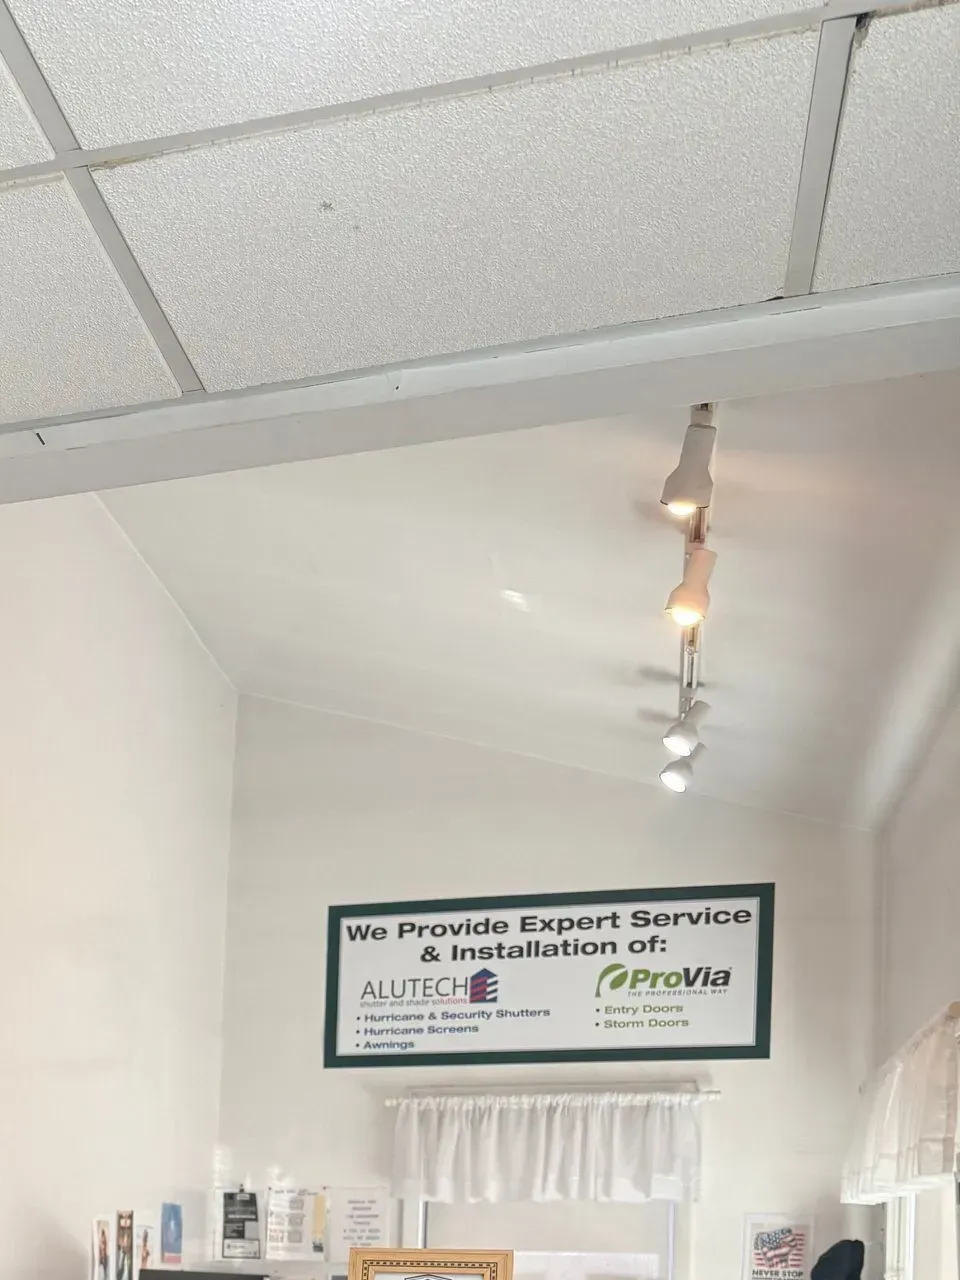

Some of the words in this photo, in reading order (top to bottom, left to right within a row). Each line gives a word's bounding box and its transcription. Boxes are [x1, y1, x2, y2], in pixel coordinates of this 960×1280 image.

[346, 924, 387, 942] We
[397, 917, 509, 939] Provide
[520, 912, 621, 935] Expert
[630, 907, 752, 928] Service
[420, 946, 441, 962] &
[451, 939, 617, 962] Installation
[628, 935, 667, 954] of:
[628, 966, 732, 990] ProVia
[360, 977, 468, 1000] ALUTECH
[360, 1000, 387, 1008] shutter
[390, 999, 404, 1007] and
[406, 998, 429, 1006] shade
[432, 997, 468, 1005] solutions
[364, 1012, 424, 1023] Hurricane
[428, 1012, 437, 1021] &
[441, 1010, 492, 1021] Security
[495, 1008, 551, 1018] Shutters
[604, 1005, 639, 1016] Entry
[643, 1004, 684, 1014] Doors
[604, 1019, 644, 1029] Storm
[648, 1018, 690, 1028] Doors
[364, 1026, 424, 1036] Hurricane
[427, 1024, 479, 1034] Screens
[363, 1040, 415, 1050] Awnings
[752, 1269, 780, 1278] NEVER
[782, 1270, 804, 1278] STOP
